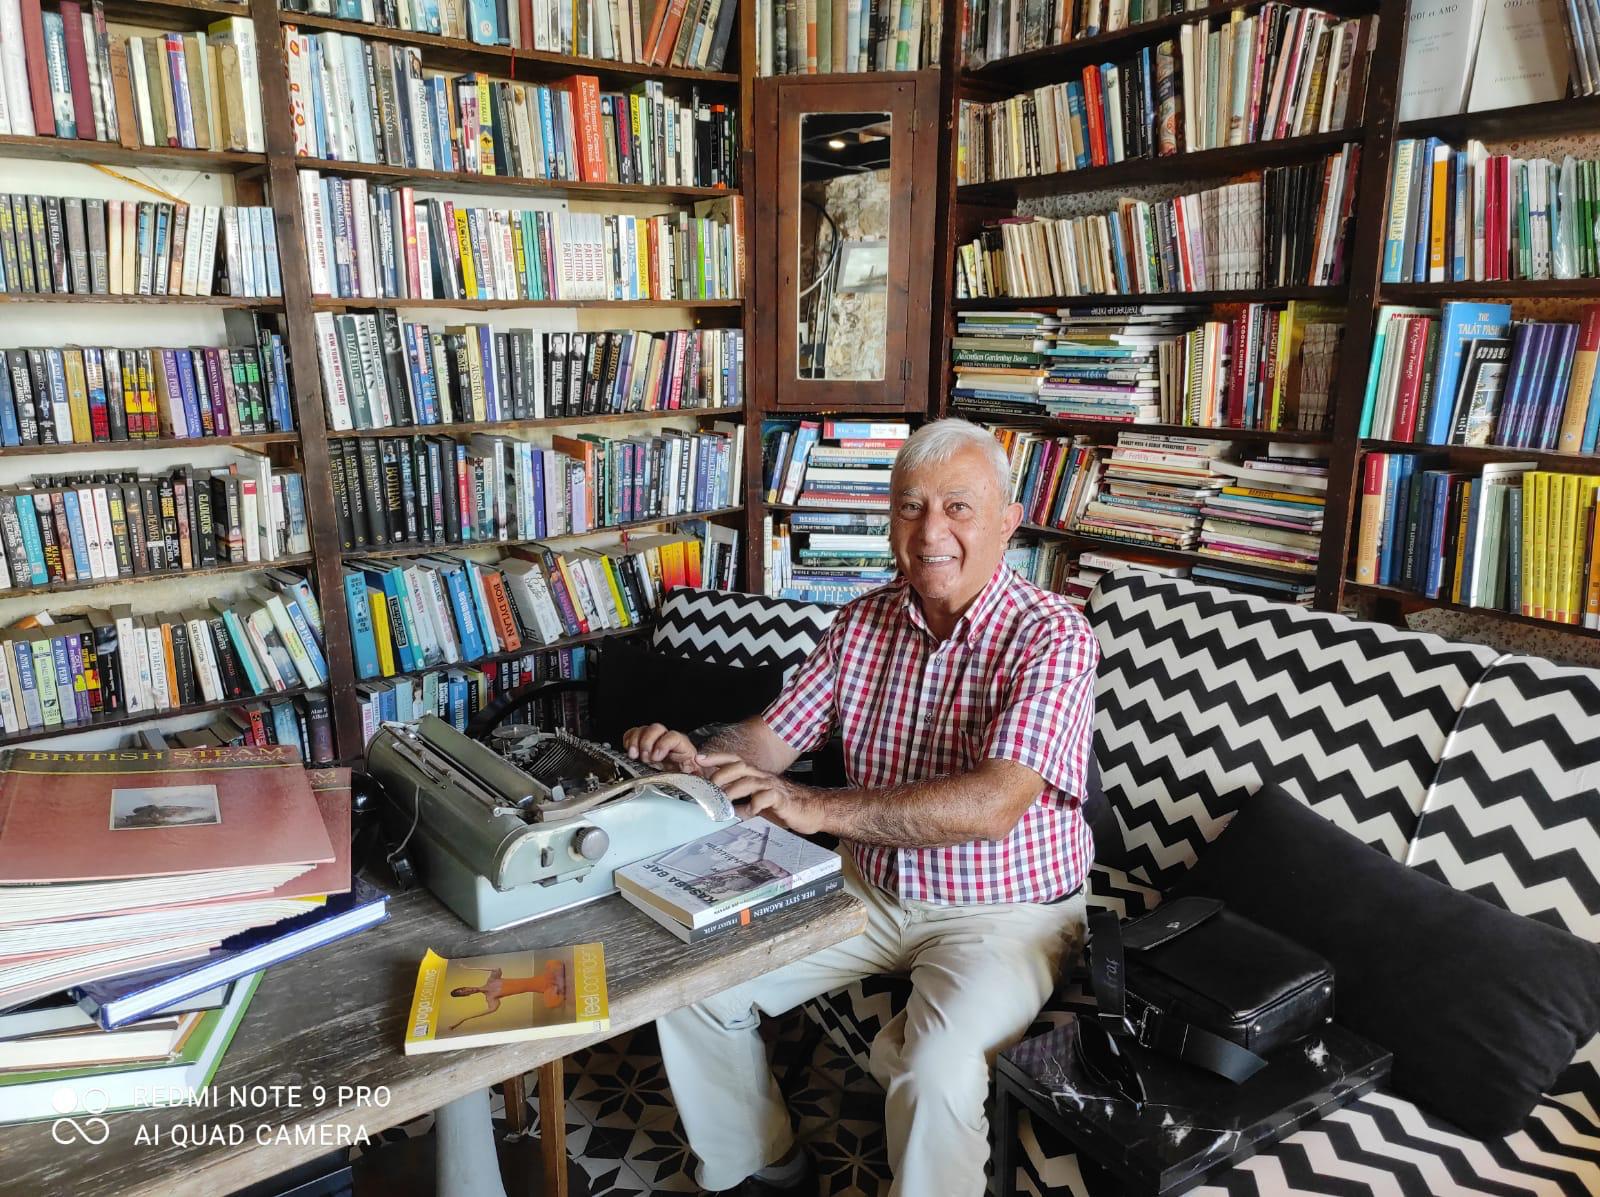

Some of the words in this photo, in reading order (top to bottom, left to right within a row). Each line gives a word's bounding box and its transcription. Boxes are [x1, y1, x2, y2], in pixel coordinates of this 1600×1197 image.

[1411, 12, 1425, 21] ODI
[1439, 6, 1458, 16] AMO
[1504, 0, 1521, 9] ODI
[381, 87, 393, 138] ALLENDE
[418, 83, 428, 130] JONATHAN
[480, 91, 489, 123] AUSTRALIA
[543, 90, 551, 118] chris
[582, 82, 591, 123] Knowledge
[589, 100, 599, 132] Ultimate
[632, 111, 640, 133] MARTIN
[422, 132, 432, 156] ROSS
[545, 120, 554, 154] evans
[593, 133, 602, 162] General
[334, 181, 344, 215] GUARDING
[343, 185, 351, 216] FERGIE
[313, 209, 321, 225] YORK
[336, 215, 346, 236] DIANA
[447, 205, 455, 228] StyleCity
[451, 231, 459, 259] ISTANBUL
[457, 217, 469, 257] FACTORY
[315, 227, 325, 269] MID-CENTURY
[469, 215, 479, 250] CAMBRIDGE
[474, 253, 483, 278] Essential
[563, 242, 574, 281] PARTITION
[574, 243, 584, 281] PARTITION
[584, 243, 593, 281] PARTITION
[594, 243, 603, 281] PARTITION
[328, 333, 336, 346] NEW
[1412, 322, 1421, 334] The
[330, 347, 339, 363] YORK
[371, 336, 380, 359] GAUNT
[1267, 332, 1277, 355] Dairy
[165, 359, 175, 377] ANNE
[208, 359, 217, 381] ADRIANA
[456, 349, 465, 373] ROME
[554, 361, 562, 378] TOTAL
[574, 361, 582, 379] TOTAL
[592, 347, 604, 381] BRUCE
[608, 346, 620, 380] BRUCE
[984, 353, 1013, 362] Gardening
[1013, 355, 1028, 363] Book
[1267, 358, 1275, 378] Free
[1406, 355, 1417, 380] Triangle
[52, 363, 60, 381] ANNE
[470, 363, 482, 401] AUSTRIA
[13, 366, 24, 403] PELECANOS
[54, 382, 64, 402] PERRY
[169, 378, 179, 397] PERRY
[212, 381, 221, 406] TRIGIANI
[332, 365, 346, 406] MID-CENTURY
[555, 380, 563, 405] RECALL
[573, 380, 581, 404] RECALL
[22, 419, 29, 427] TO
[336, 458, 345, 479] LOUISE
[363, 454, 371, 467] ART
[386, 466, 401, 511] BOTHAM
[420, 476, 428, 506] HUNTERS
[679, 469, 687, 496] REMAINS
[707, 464, 715, 494] DRUIDS
[339, 480, 349, 517] NEVELSON
[354, 476, 363, 513] NEVELSON
[373, 476, 382, 512] NEVELSON
[475, 479, 484, 511] Ireland
[159, 498, 168, 517] WOODS
[198, 494, 213, 534] GLADIATORS
[41, 515, 50, 530] BARRY
[148, 514, 160, 541] DEAVER
[45, 547, 55, 565] RAIN
[52, 546, 61, 575] KILLING
[165, 535, 173, 562] ORCHID
[16, 571, 25, 582] PAY
[21, 562, 30, 578] HELL
[815, 589, 846, 601] THE
[493, 584, 505, 603] BOB
[501, 605, 514, 638] DYLAN
[191, 624, 199, 633] LEN
[212, 623, 226, 650] SLAUGHTER
[56, 649, 65, 665] ANNE
[193, 634, 204, 662] DEIGHTON
[20, 653, 29, 669] ANNE
[152, 652, 162, 671] TRACY
[23, 670, 33, 689] PERRY
[58, 666, 69, 685] PERRY
[25, 751, 165, 761] BRITISH
[173, 747, 283, 759] STEAM
[643, 864, 670, 878] BAF
[668, 876, 718, 904] KASABA
[801, 890, 815, 901] HER
[753, 902, 783, 917] RAĞMEN
[416, 1001, 432, 1024] yoga
[580, 994, 600, 1016] feel
